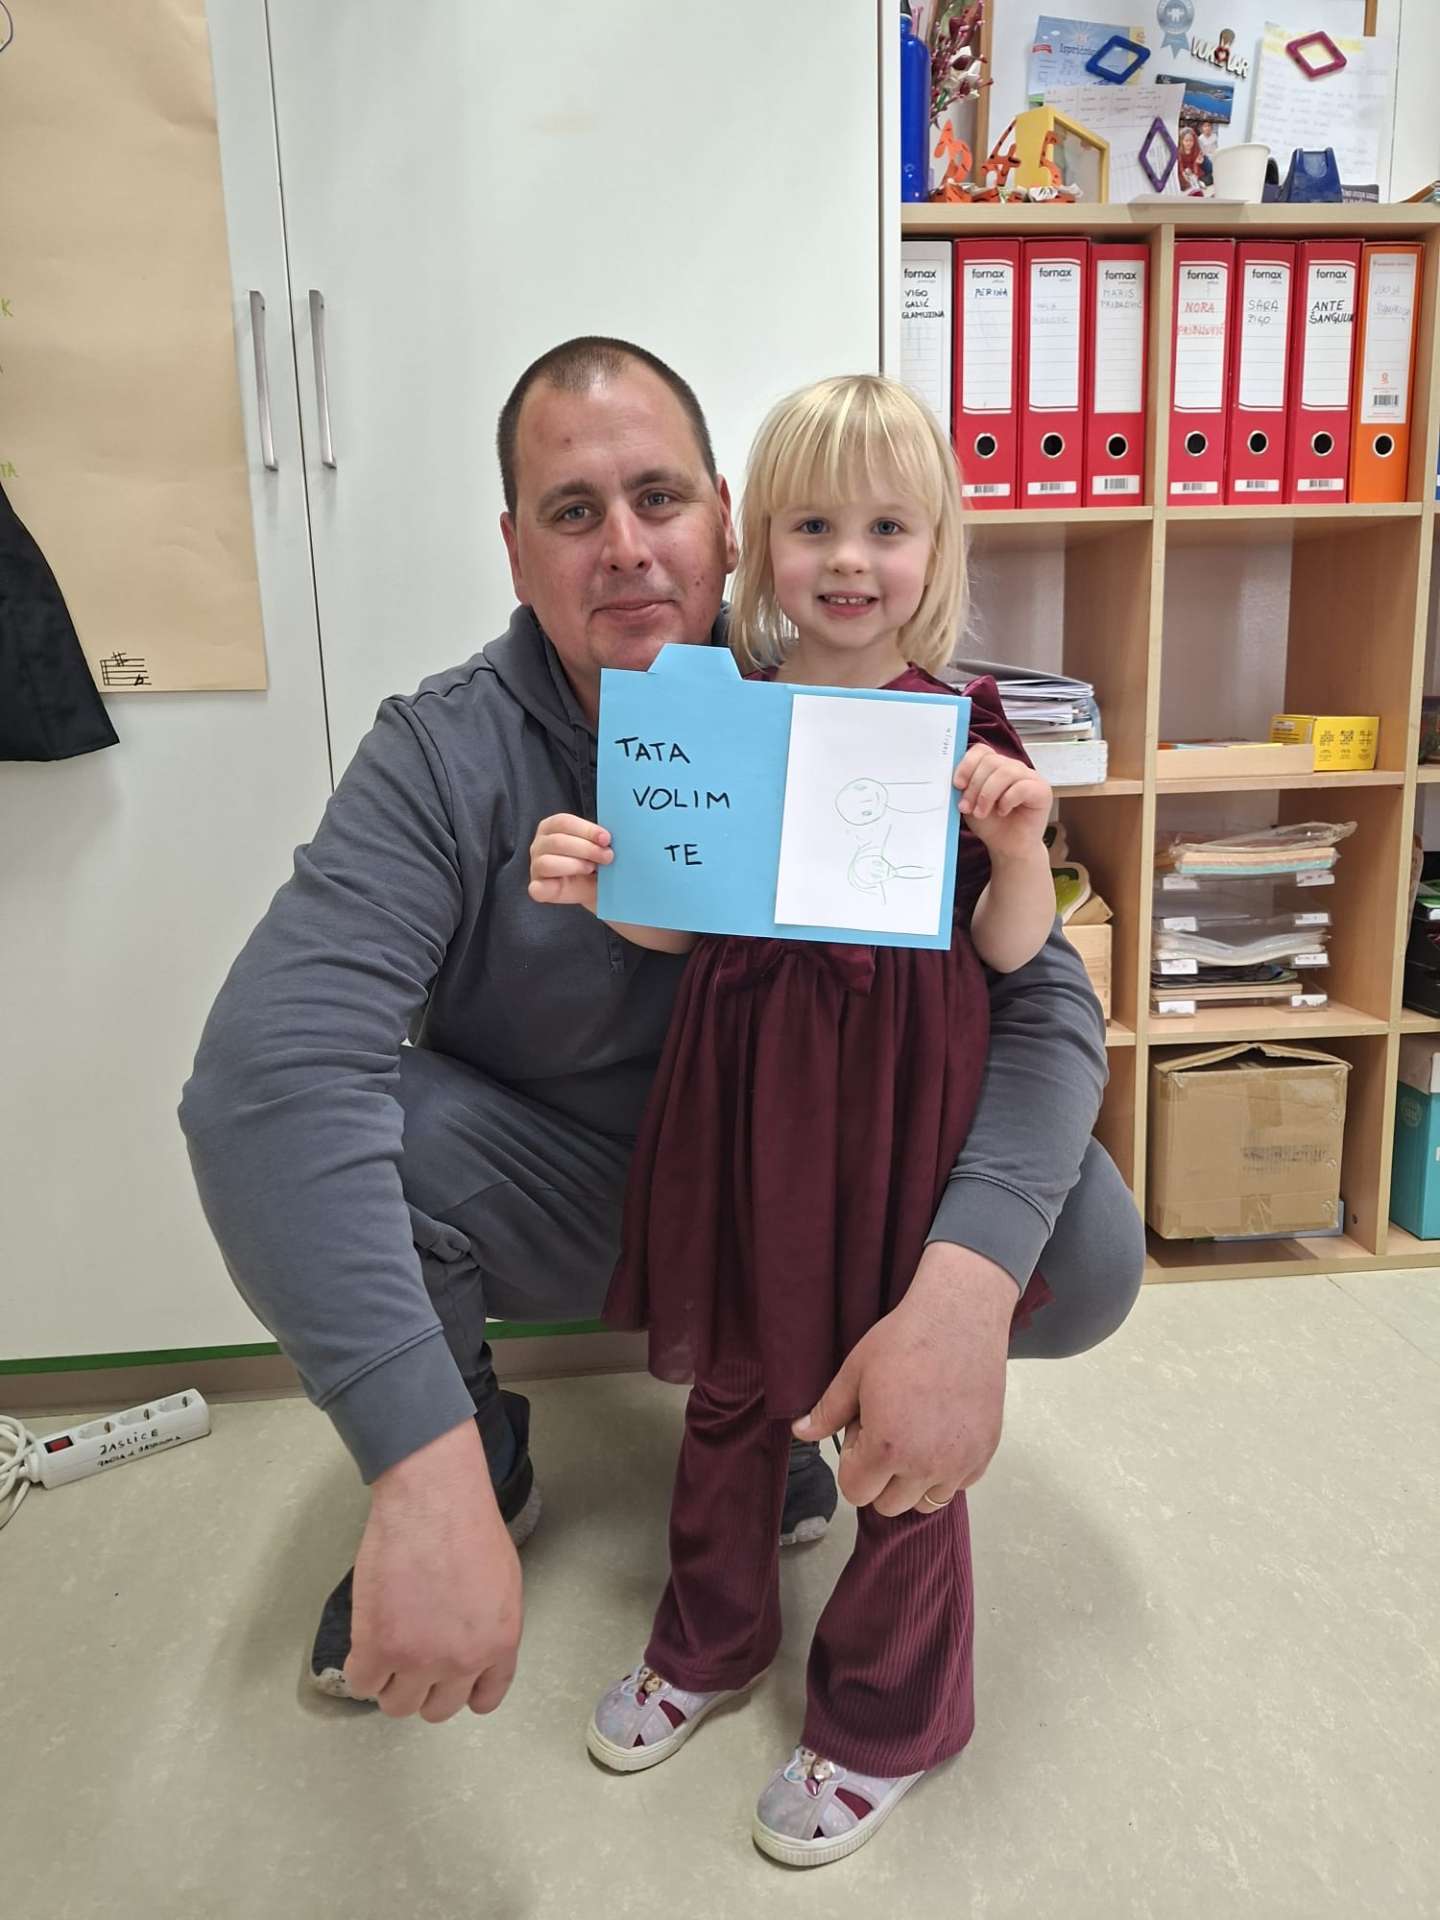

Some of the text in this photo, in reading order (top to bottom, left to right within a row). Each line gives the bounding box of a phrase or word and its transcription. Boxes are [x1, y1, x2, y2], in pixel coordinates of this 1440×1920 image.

[903, 268, 937, 279] fornax
[971, 268, 1005, 279] fornax
[1039, 267, 1072, 278] fornax
[1104, 269, 1137, 280] fornax
[1186, 269, 1219, 280] fornax
[1252, 268, 1282, 280] fornax
[1316, 269, 1348, 279] fornax
[1311, 299, 1345, 312] ANTE
[614, 737, 691, 764] TATA
[632, 786, 730, 810] VOLIM
[664, 843, 703, 866] TE
